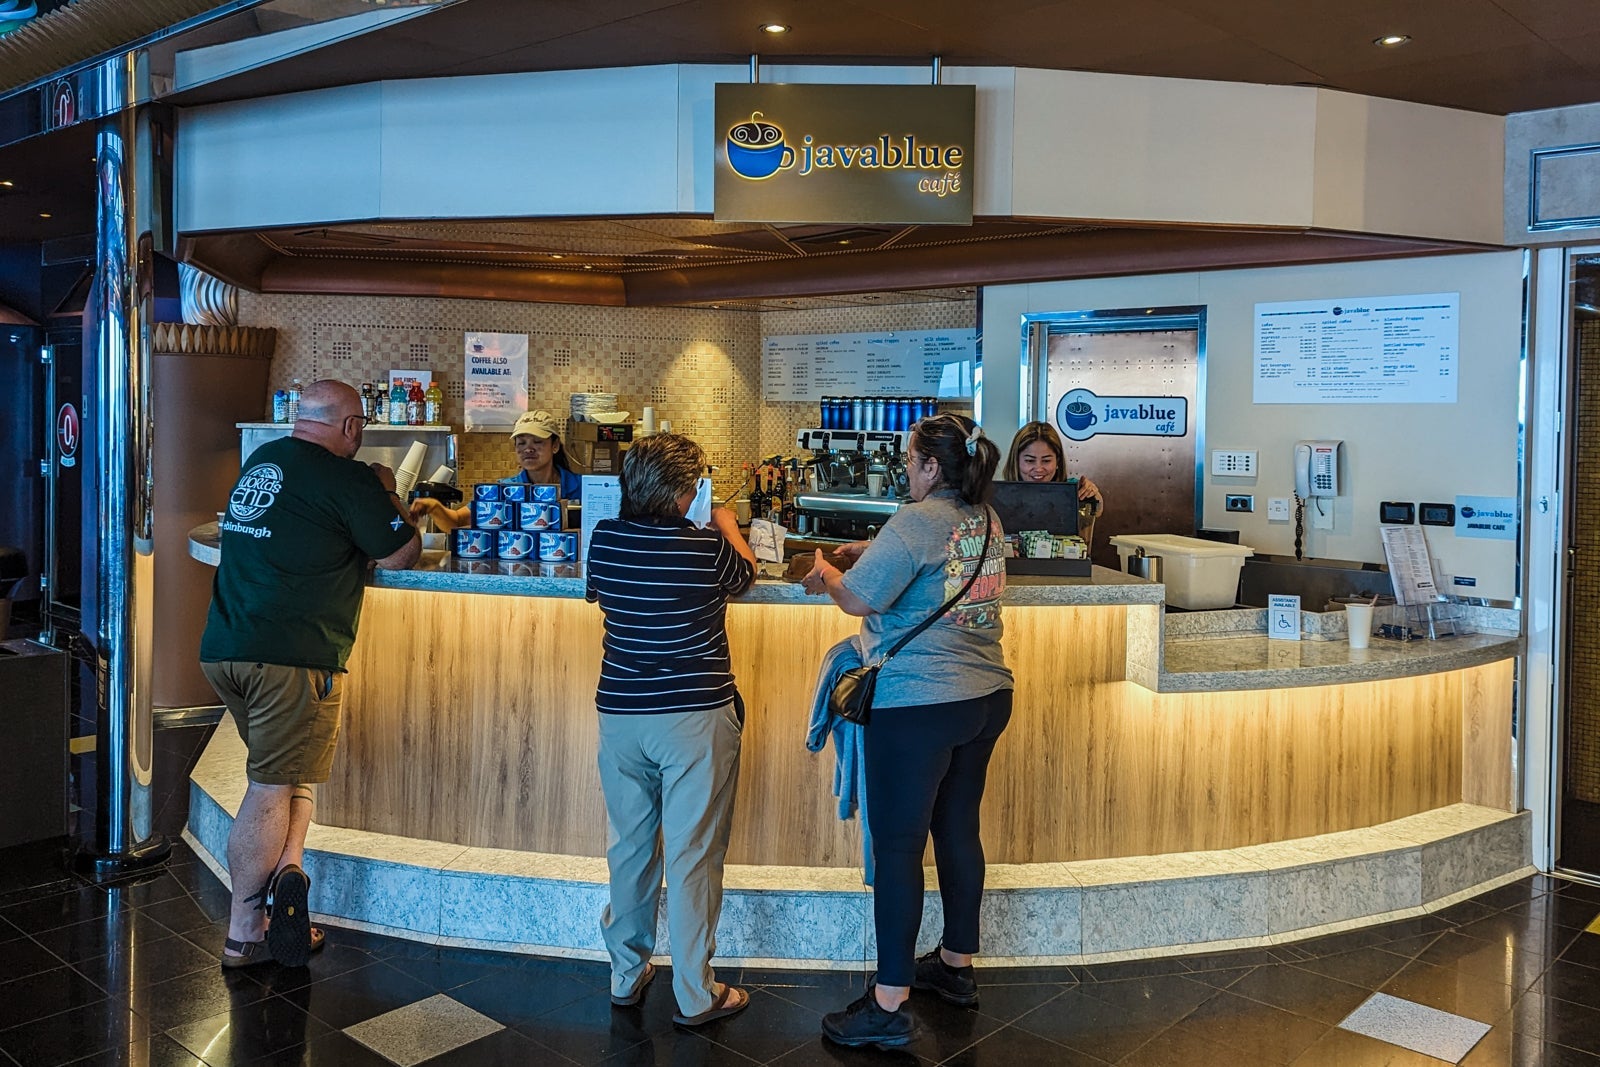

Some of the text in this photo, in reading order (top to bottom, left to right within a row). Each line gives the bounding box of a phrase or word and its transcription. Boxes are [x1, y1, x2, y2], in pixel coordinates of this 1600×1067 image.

[799, 134, 963, 176] javablue
[917, 171, 962, 198] café
[471, 356, 508, 365] COFFEE ALSO
[471, 367, 501, 376] AVAILABLE
[1103, 404, 1176, 422] javablue
[1155, 421, 1175, 433] café
[1476, 509, 1513, 518] javablue
